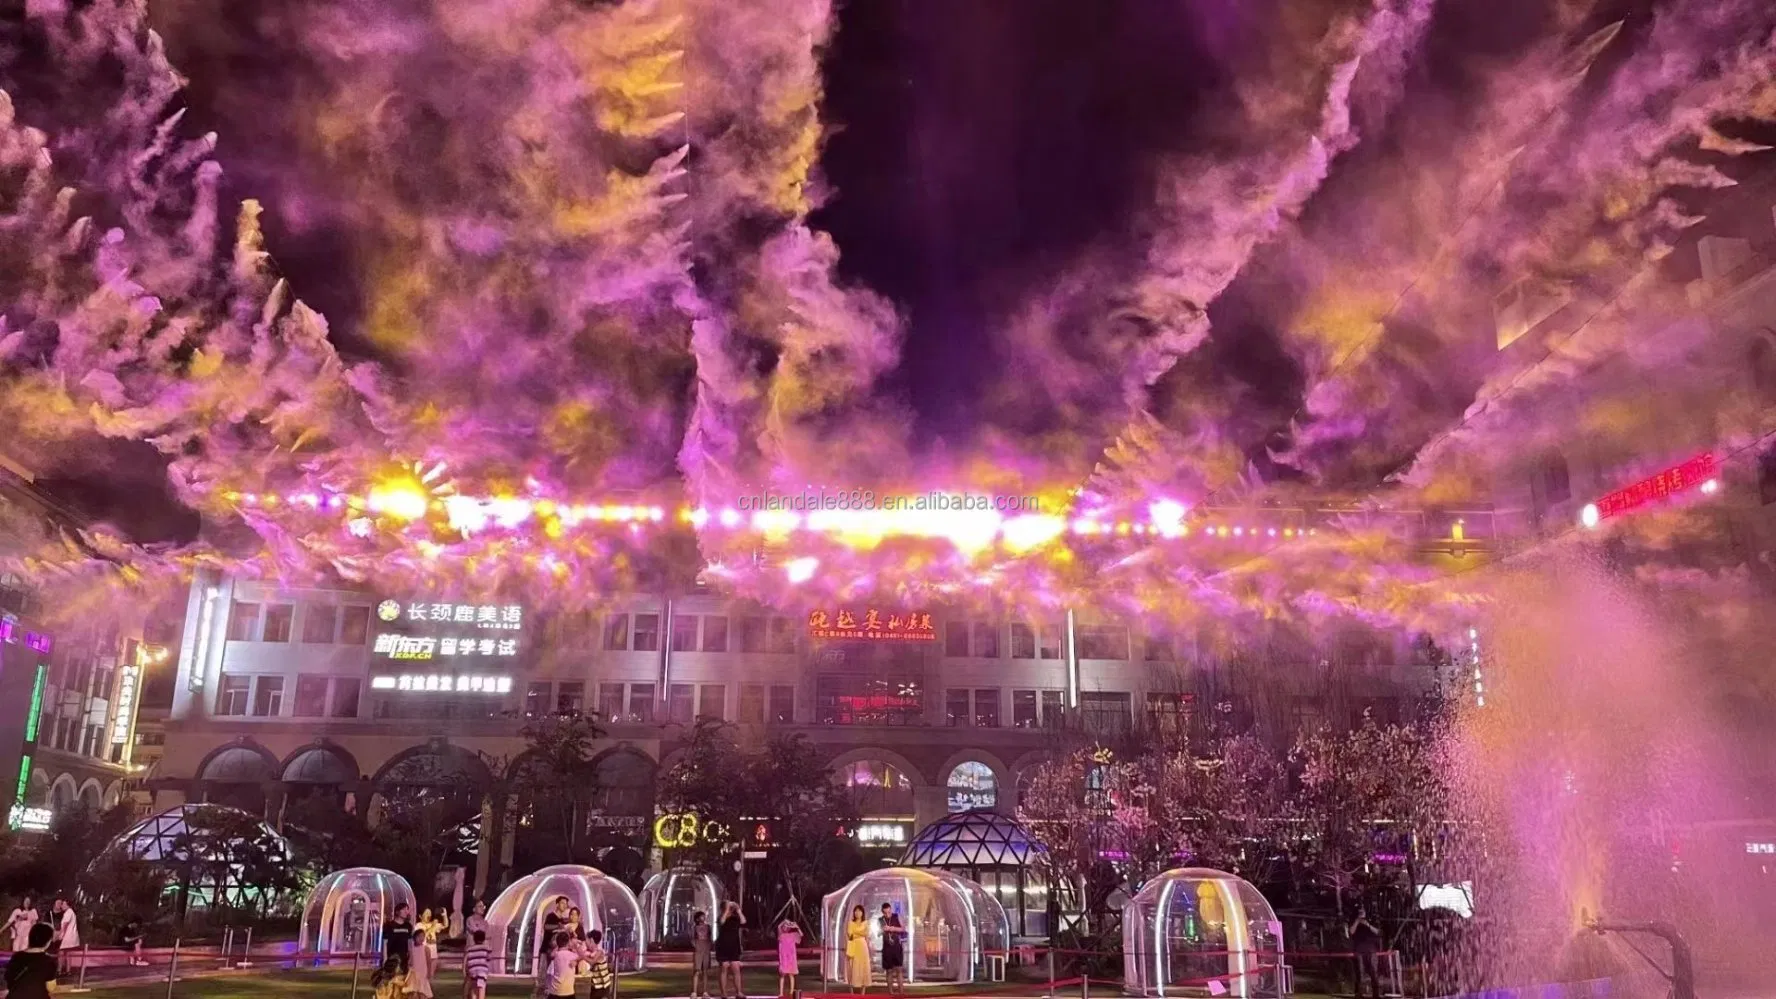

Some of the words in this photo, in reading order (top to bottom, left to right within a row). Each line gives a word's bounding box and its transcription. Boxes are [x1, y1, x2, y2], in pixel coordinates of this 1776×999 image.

[407, 603, 522, 622] 长颈鹿美语
[374, 633, 437, 658] 新东方
[440, 637, 516, 656] 留学考试
